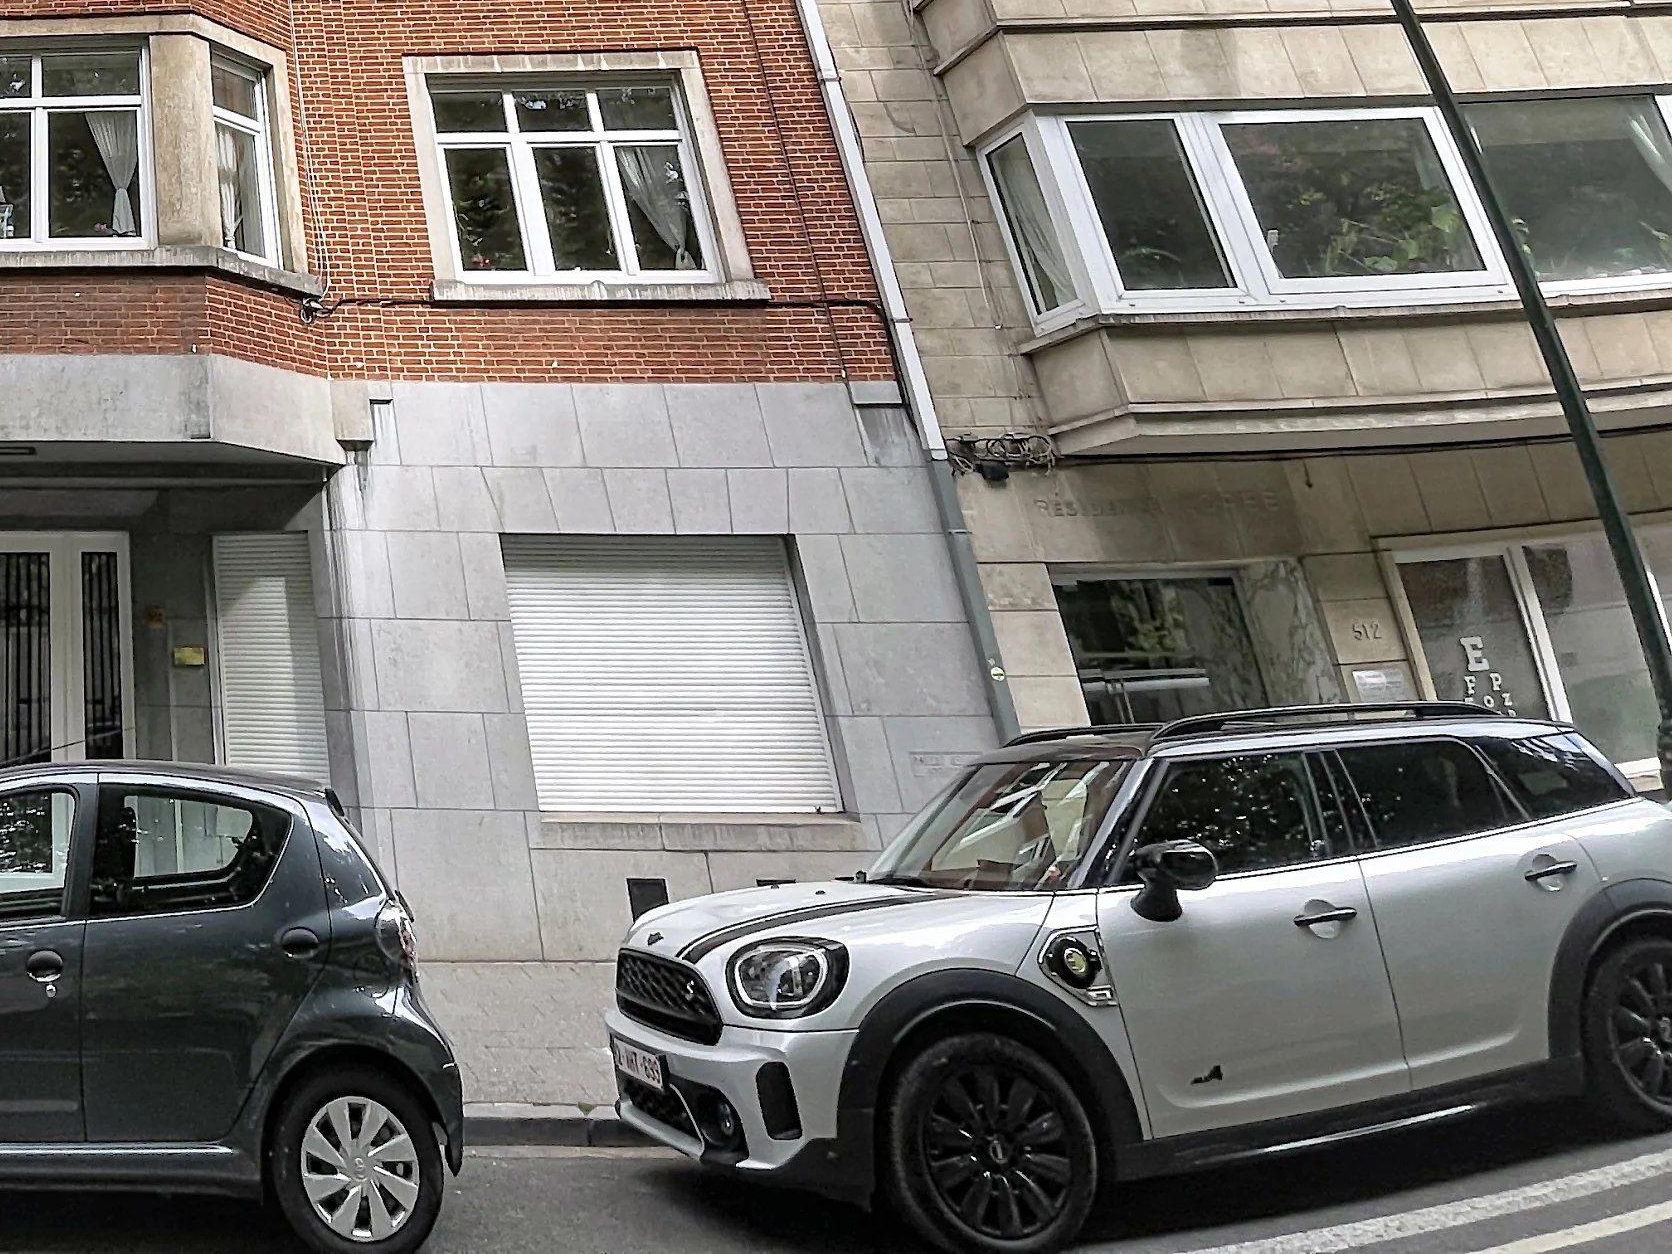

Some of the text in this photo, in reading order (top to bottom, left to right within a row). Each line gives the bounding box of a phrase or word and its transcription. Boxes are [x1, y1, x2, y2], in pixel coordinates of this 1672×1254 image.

[1352, 621, 1382, 641] 512
[1459, 636, 1490, 672] E
[1464, 673, 1502, 695] F P
